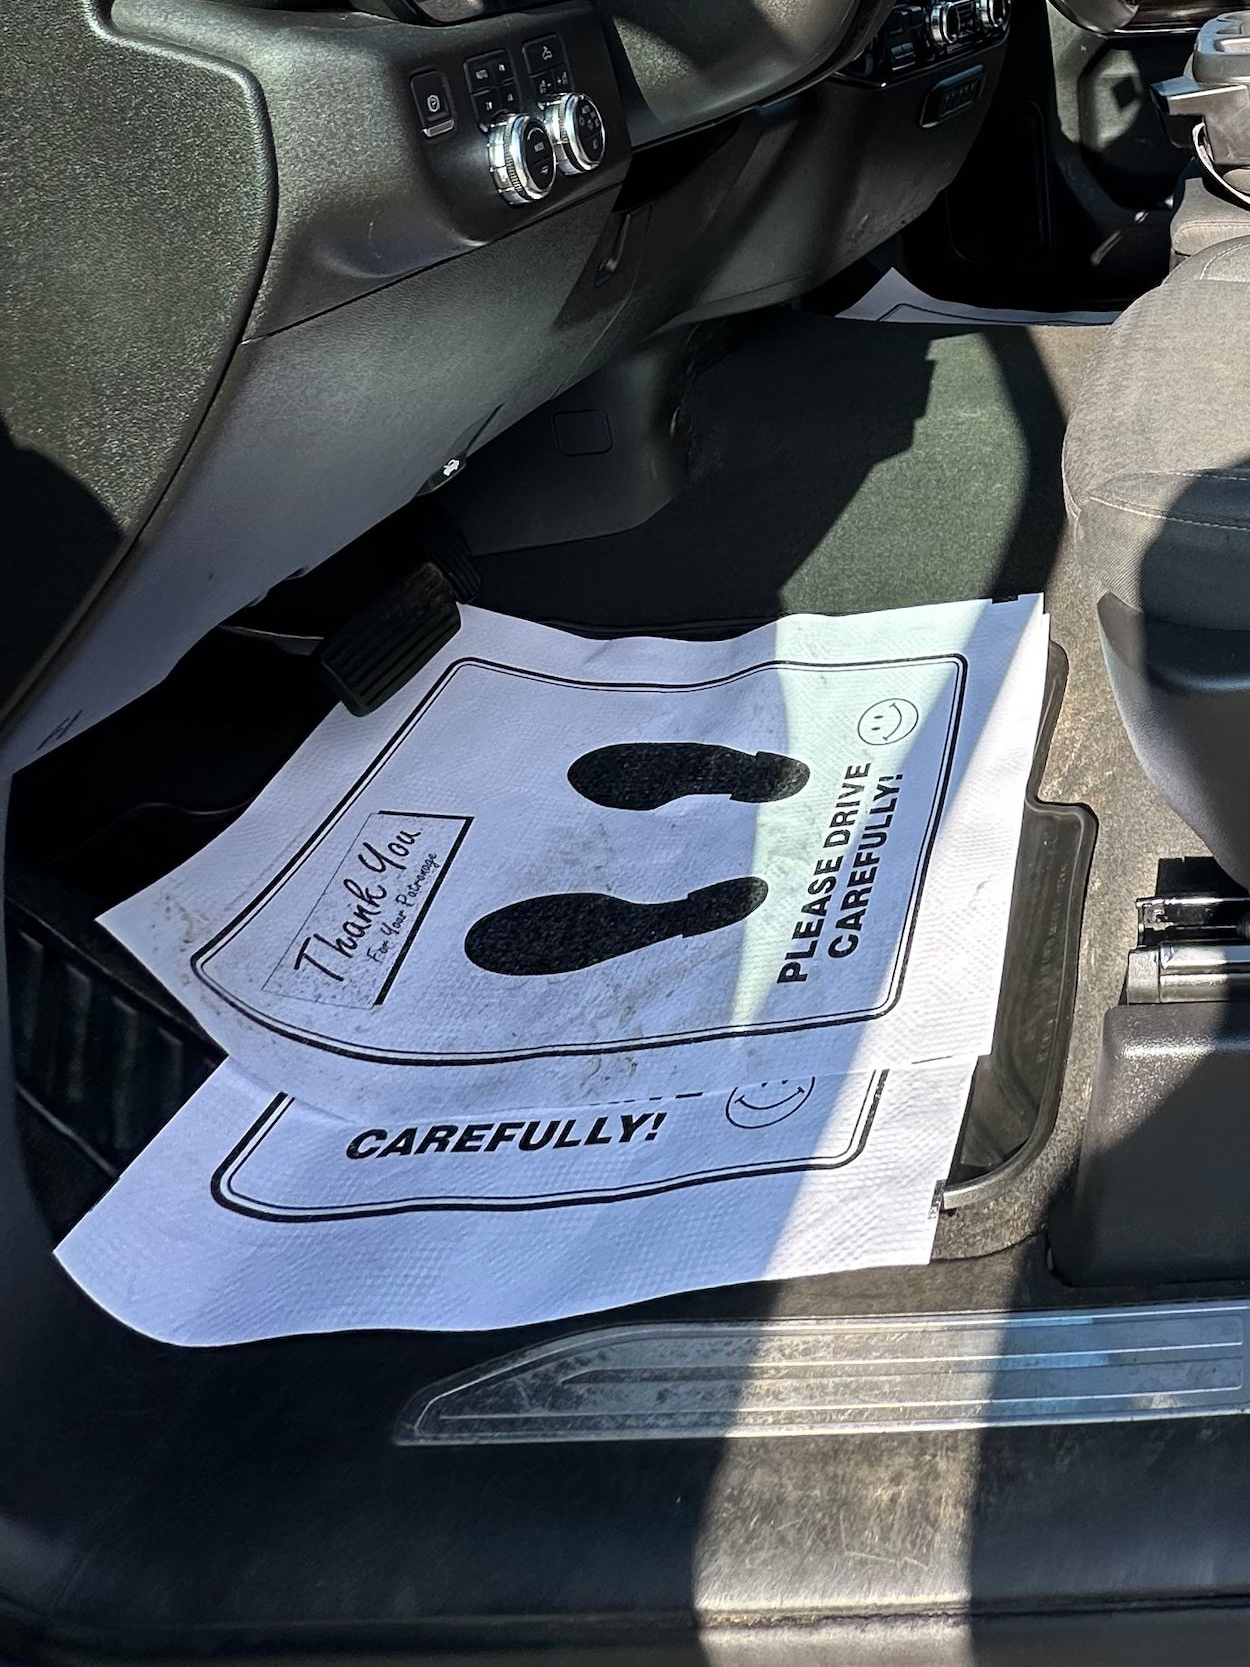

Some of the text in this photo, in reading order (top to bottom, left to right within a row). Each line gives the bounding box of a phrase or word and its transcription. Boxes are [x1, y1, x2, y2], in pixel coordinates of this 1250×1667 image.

[293, 830, 422, 982] Thank You
[366, 852, 441, 964] For Your Patronage
[776, 762, 872, 984] PLEASE DRIVE
[827, 772, 904, 959] CAREFULLY!
[345, 1112, 668, 1161] CAREFULLY!
